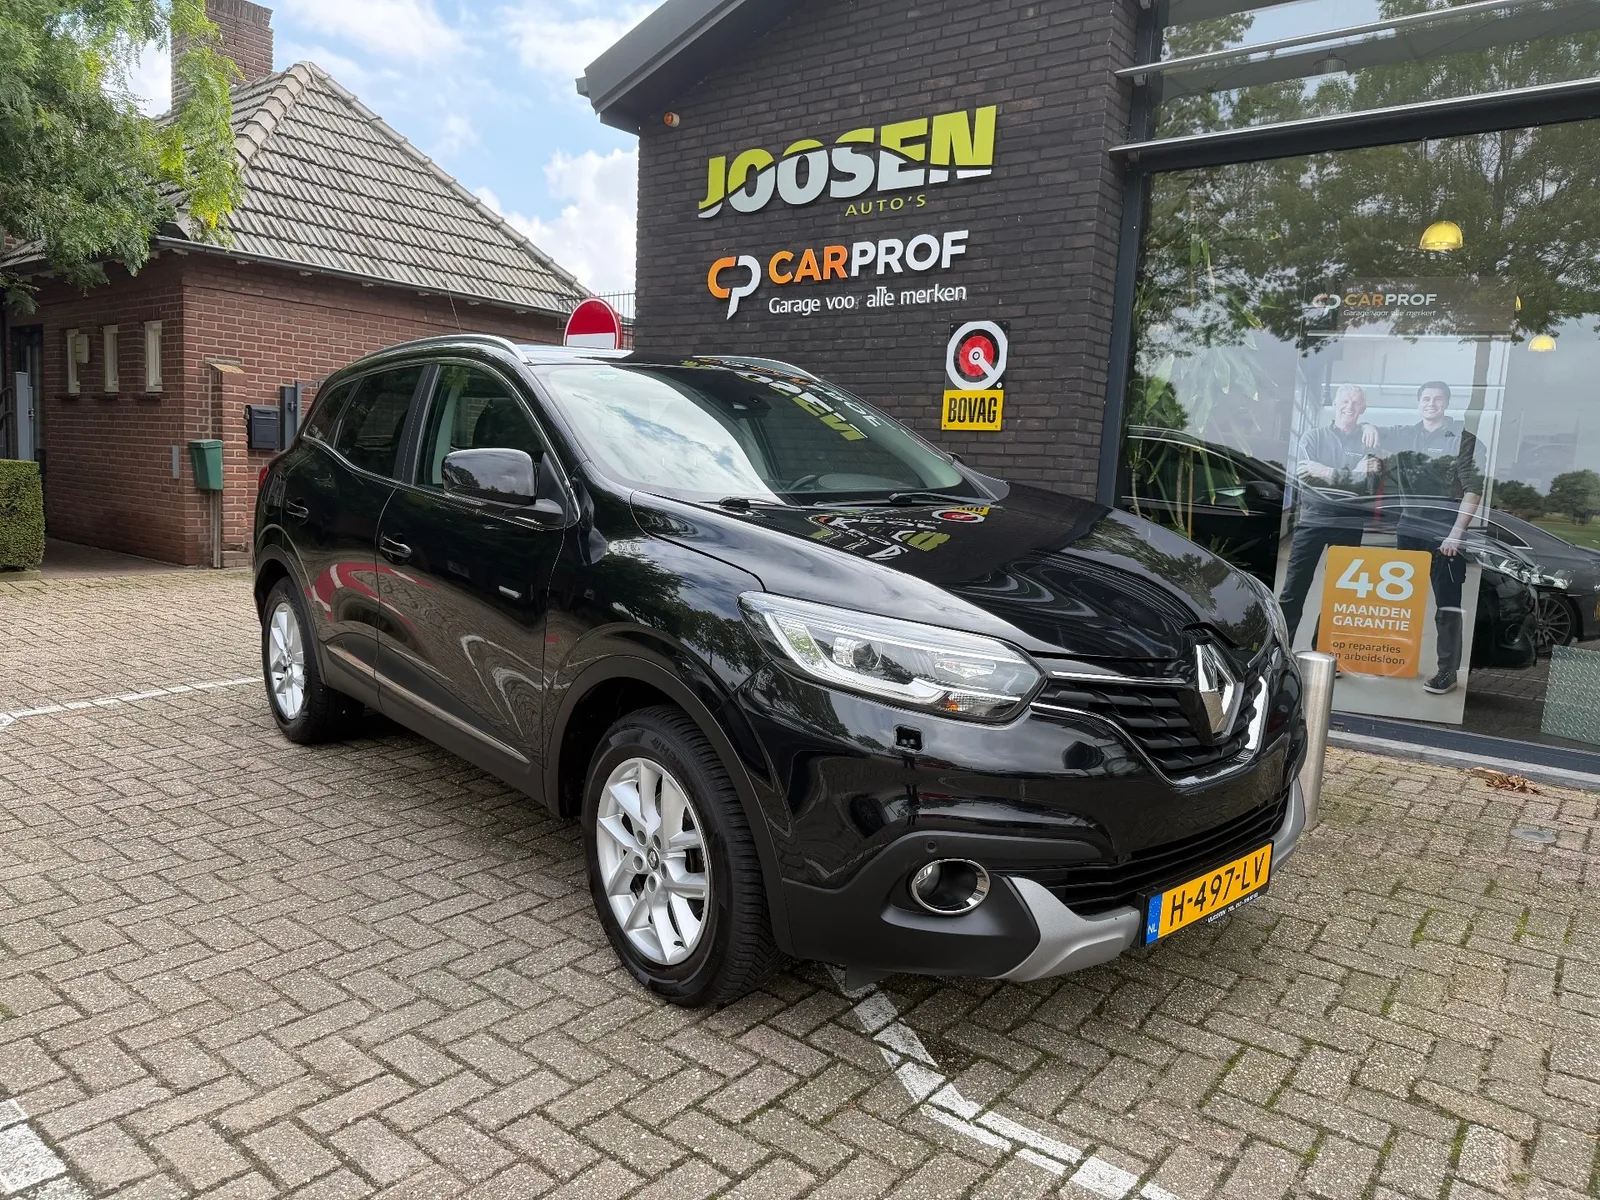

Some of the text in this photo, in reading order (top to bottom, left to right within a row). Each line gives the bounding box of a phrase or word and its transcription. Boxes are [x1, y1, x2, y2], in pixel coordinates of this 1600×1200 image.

[698, 105, 997, 219] JOOSEN
[845, 194, 926, 217] AUTO'S
[768, 230, 969, 284] CARPROF
[768, 297, 821, 316] Garage
[866, 286, 894, 307] alle
[900, 283, 967, 305] merken
[1344, 293, 1438, 306] CARPROF
[947, 397, 998, 424] BOVAG
[1335, 558, 1415, 601] 48
[1333, 602, 1412, 619] MAANDEN
[1332, 615, 1410, 631] GARANTIE
[1332, 641, 1401, 654] op reparaties
[1344, 652, 1405, 665] arbeidsloon
[1169, 852, 1265, 927] H-497-LV
[1147, 923, 1158, 935] NL
